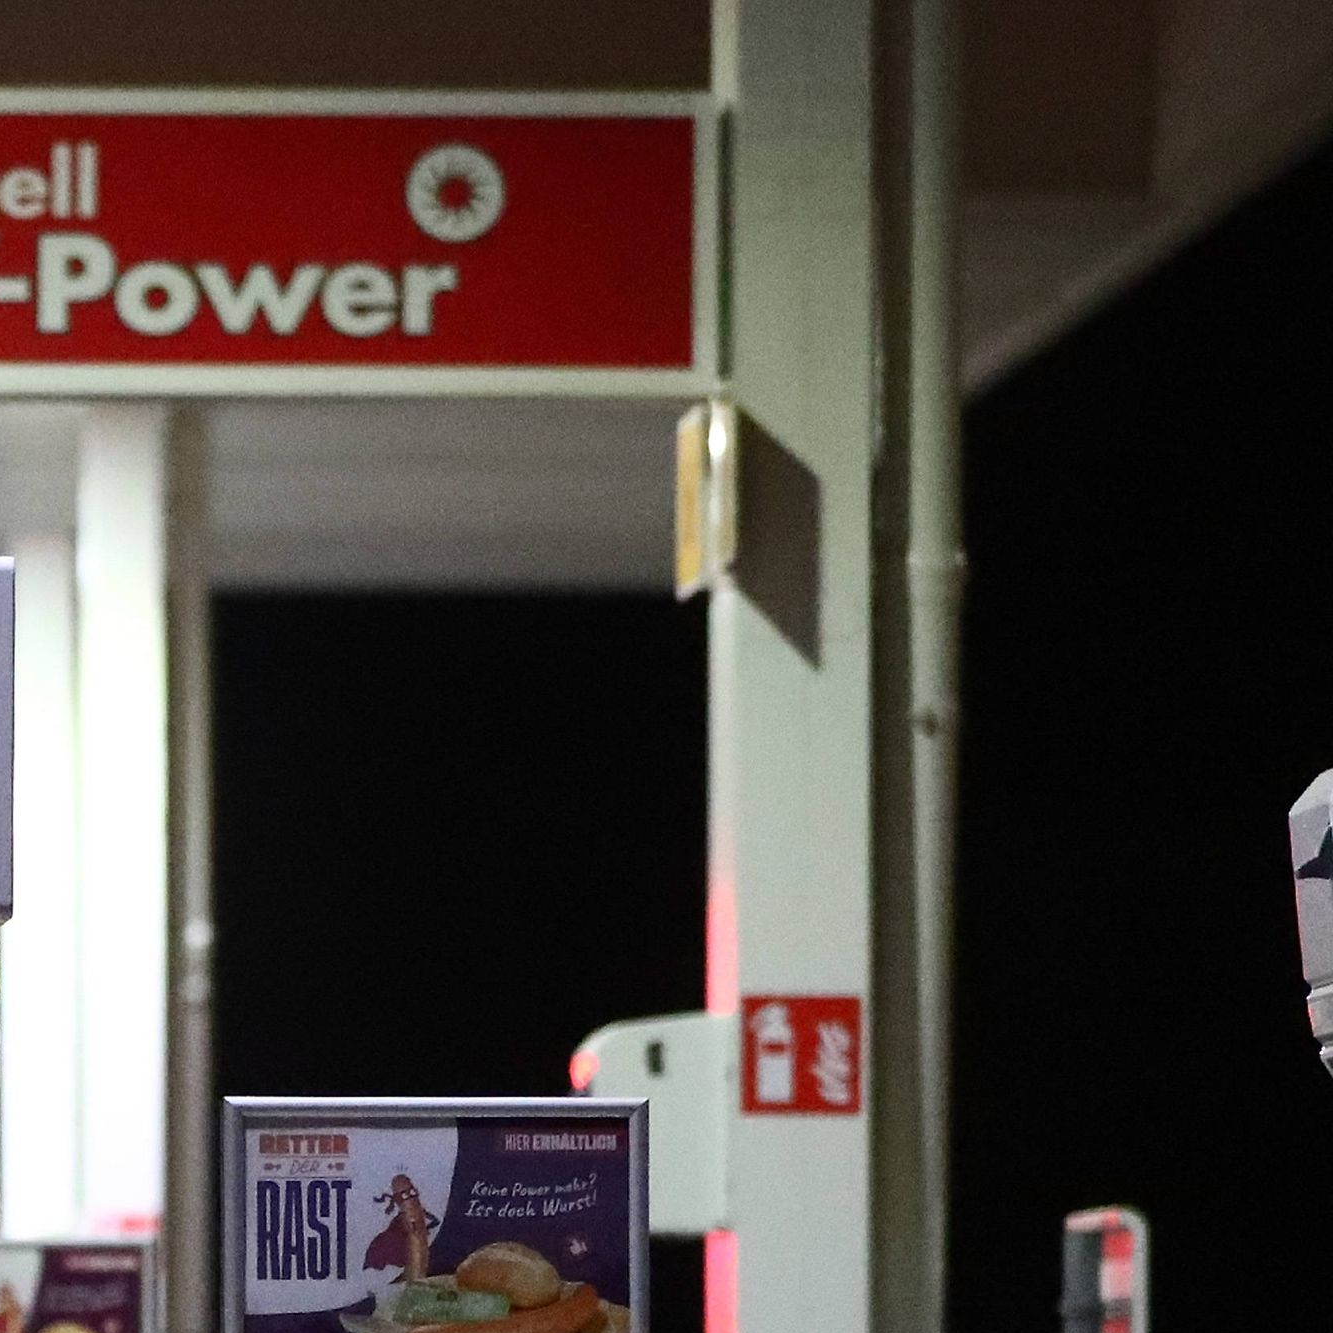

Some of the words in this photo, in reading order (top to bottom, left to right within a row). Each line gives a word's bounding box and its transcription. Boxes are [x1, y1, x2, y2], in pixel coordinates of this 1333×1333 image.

[505, 1133, 531, 1151] HIER
[471, 1181, 508, 1197] Keine
[512, 1182, 551, 1197] Power
[555, 1172, 598, 1194] mehr?
[464, 1200, 493, 1217] Iss
[498, 1201, 536, 1218] doch
[543, 1189, 597, 1217] Wurst!
[257, 1179, 353, 1281] RAST
